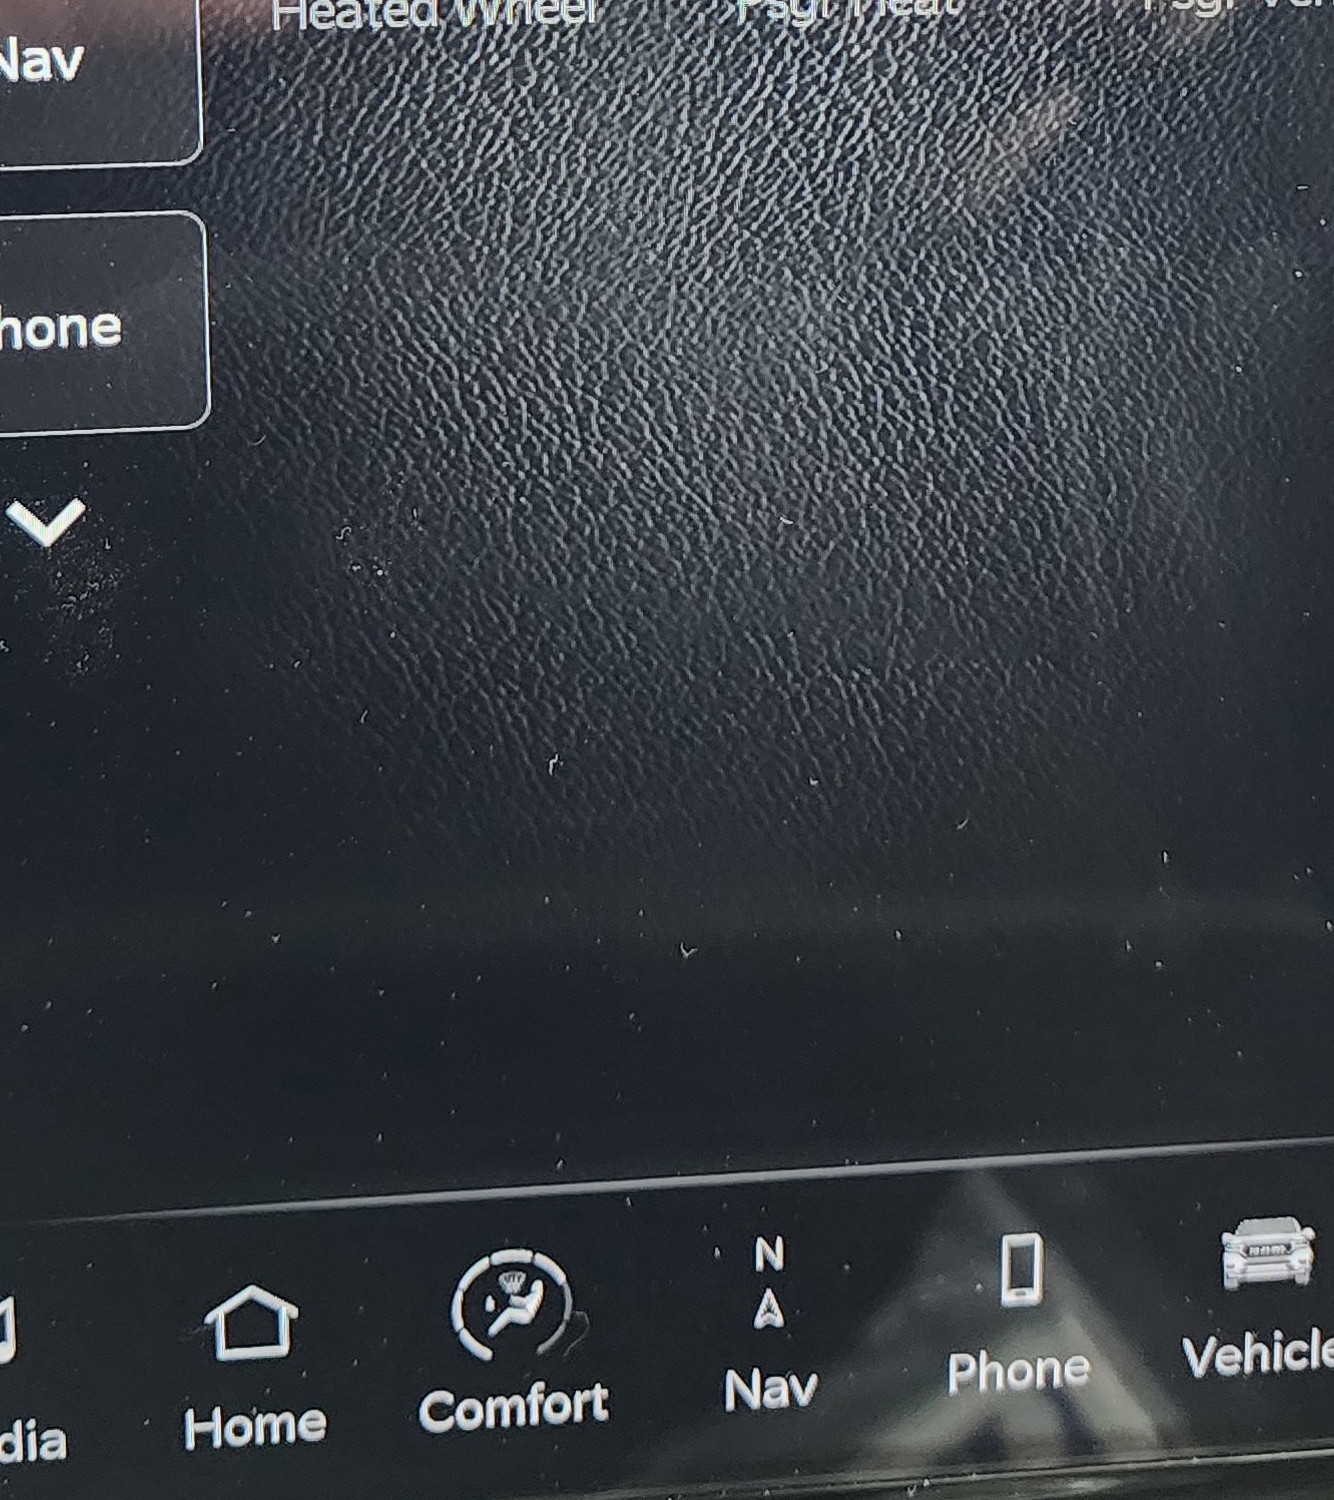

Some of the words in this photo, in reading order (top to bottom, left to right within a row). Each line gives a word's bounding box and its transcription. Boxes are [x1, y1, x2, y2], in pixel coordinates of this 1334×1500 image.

[754, 1235, 785, 1273] N
[723, 1367, 819, 1413] Nav
[947, 1349, 1093, 1396] Phone
[184, 1405, 328, 1452] Home
[418, 1381, 610, 1434] Comfort
